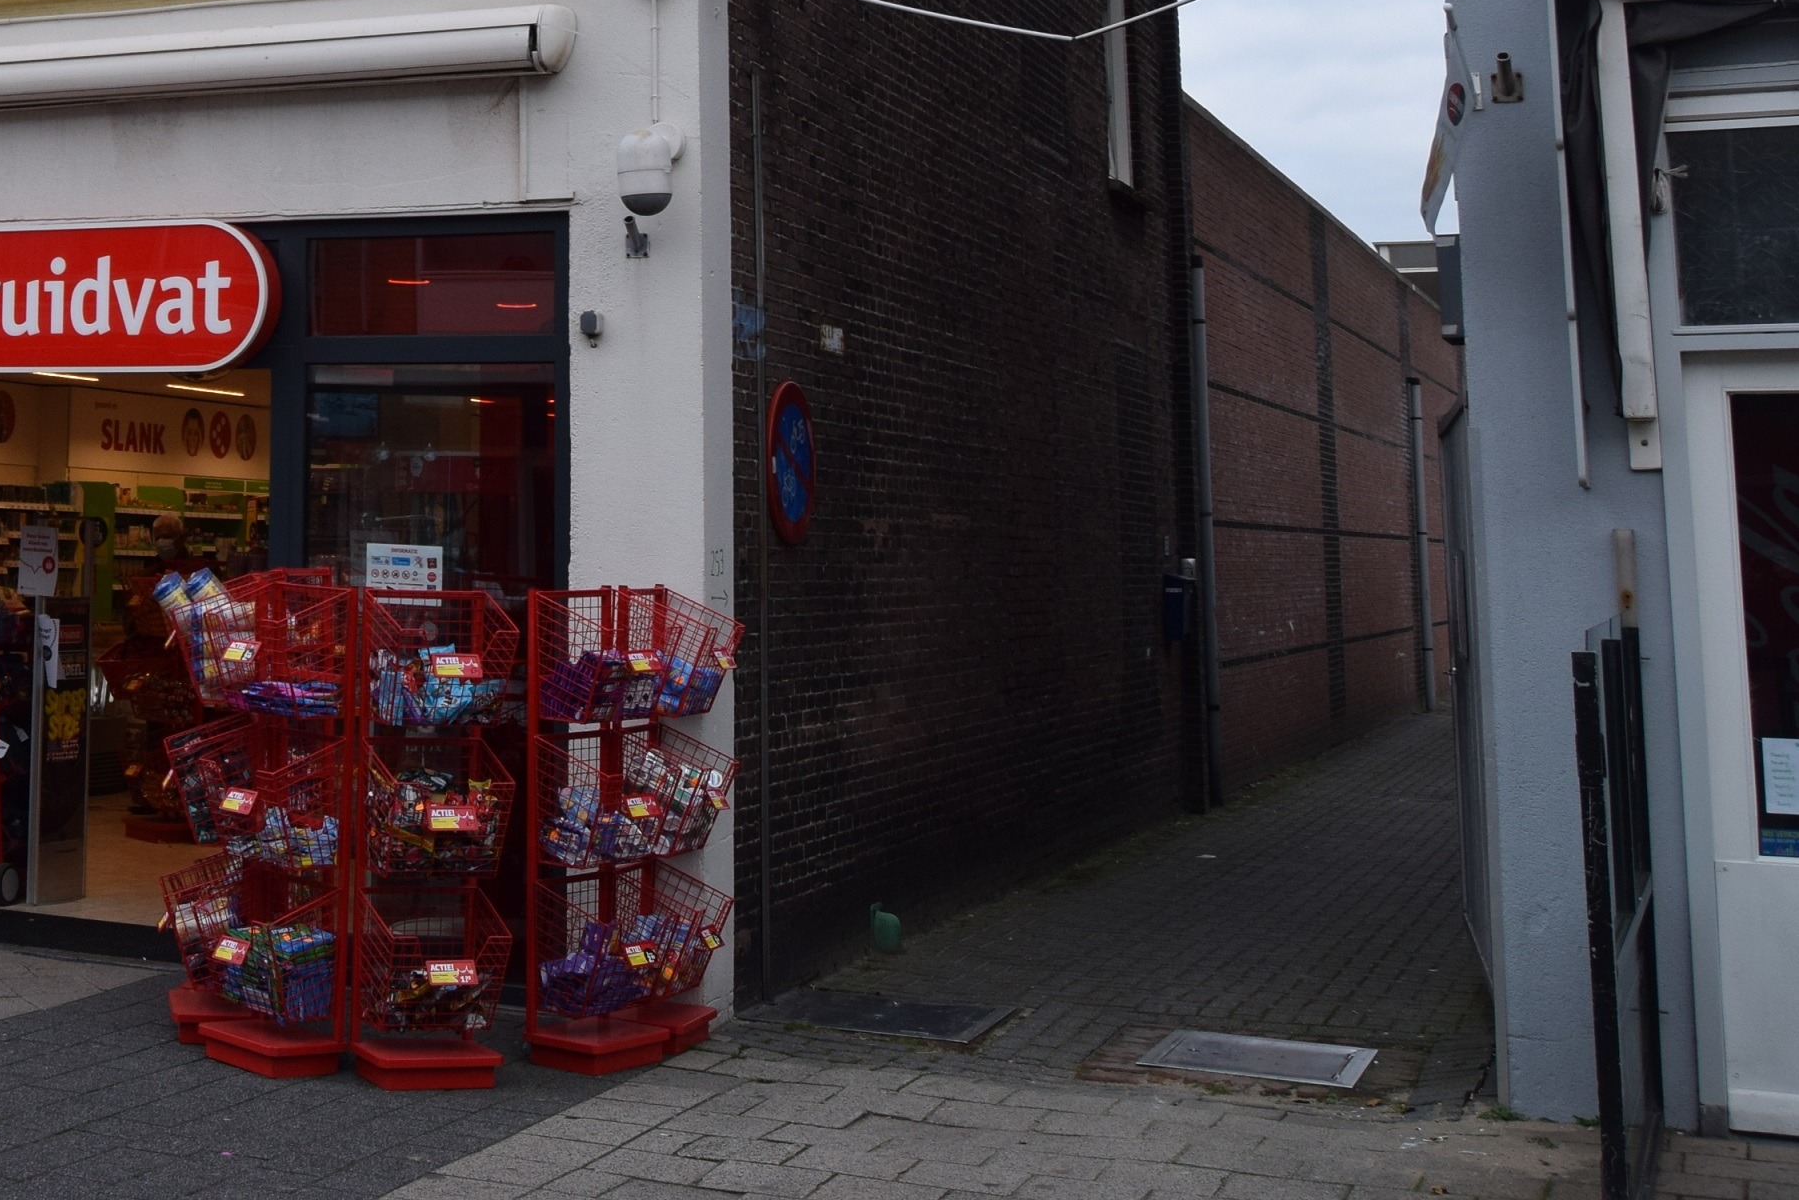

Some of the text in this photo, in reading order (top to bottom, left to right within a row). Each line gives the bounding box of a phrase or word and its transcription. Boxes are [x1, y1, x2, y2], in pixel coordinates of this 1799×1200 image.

[101, 417, 165, 455] SLANK
[436, 656, 460, 665] ACTIE!
[431, 809, 456, 817] ACTIE!
[430, 964, 455, 972] ACTIE!
